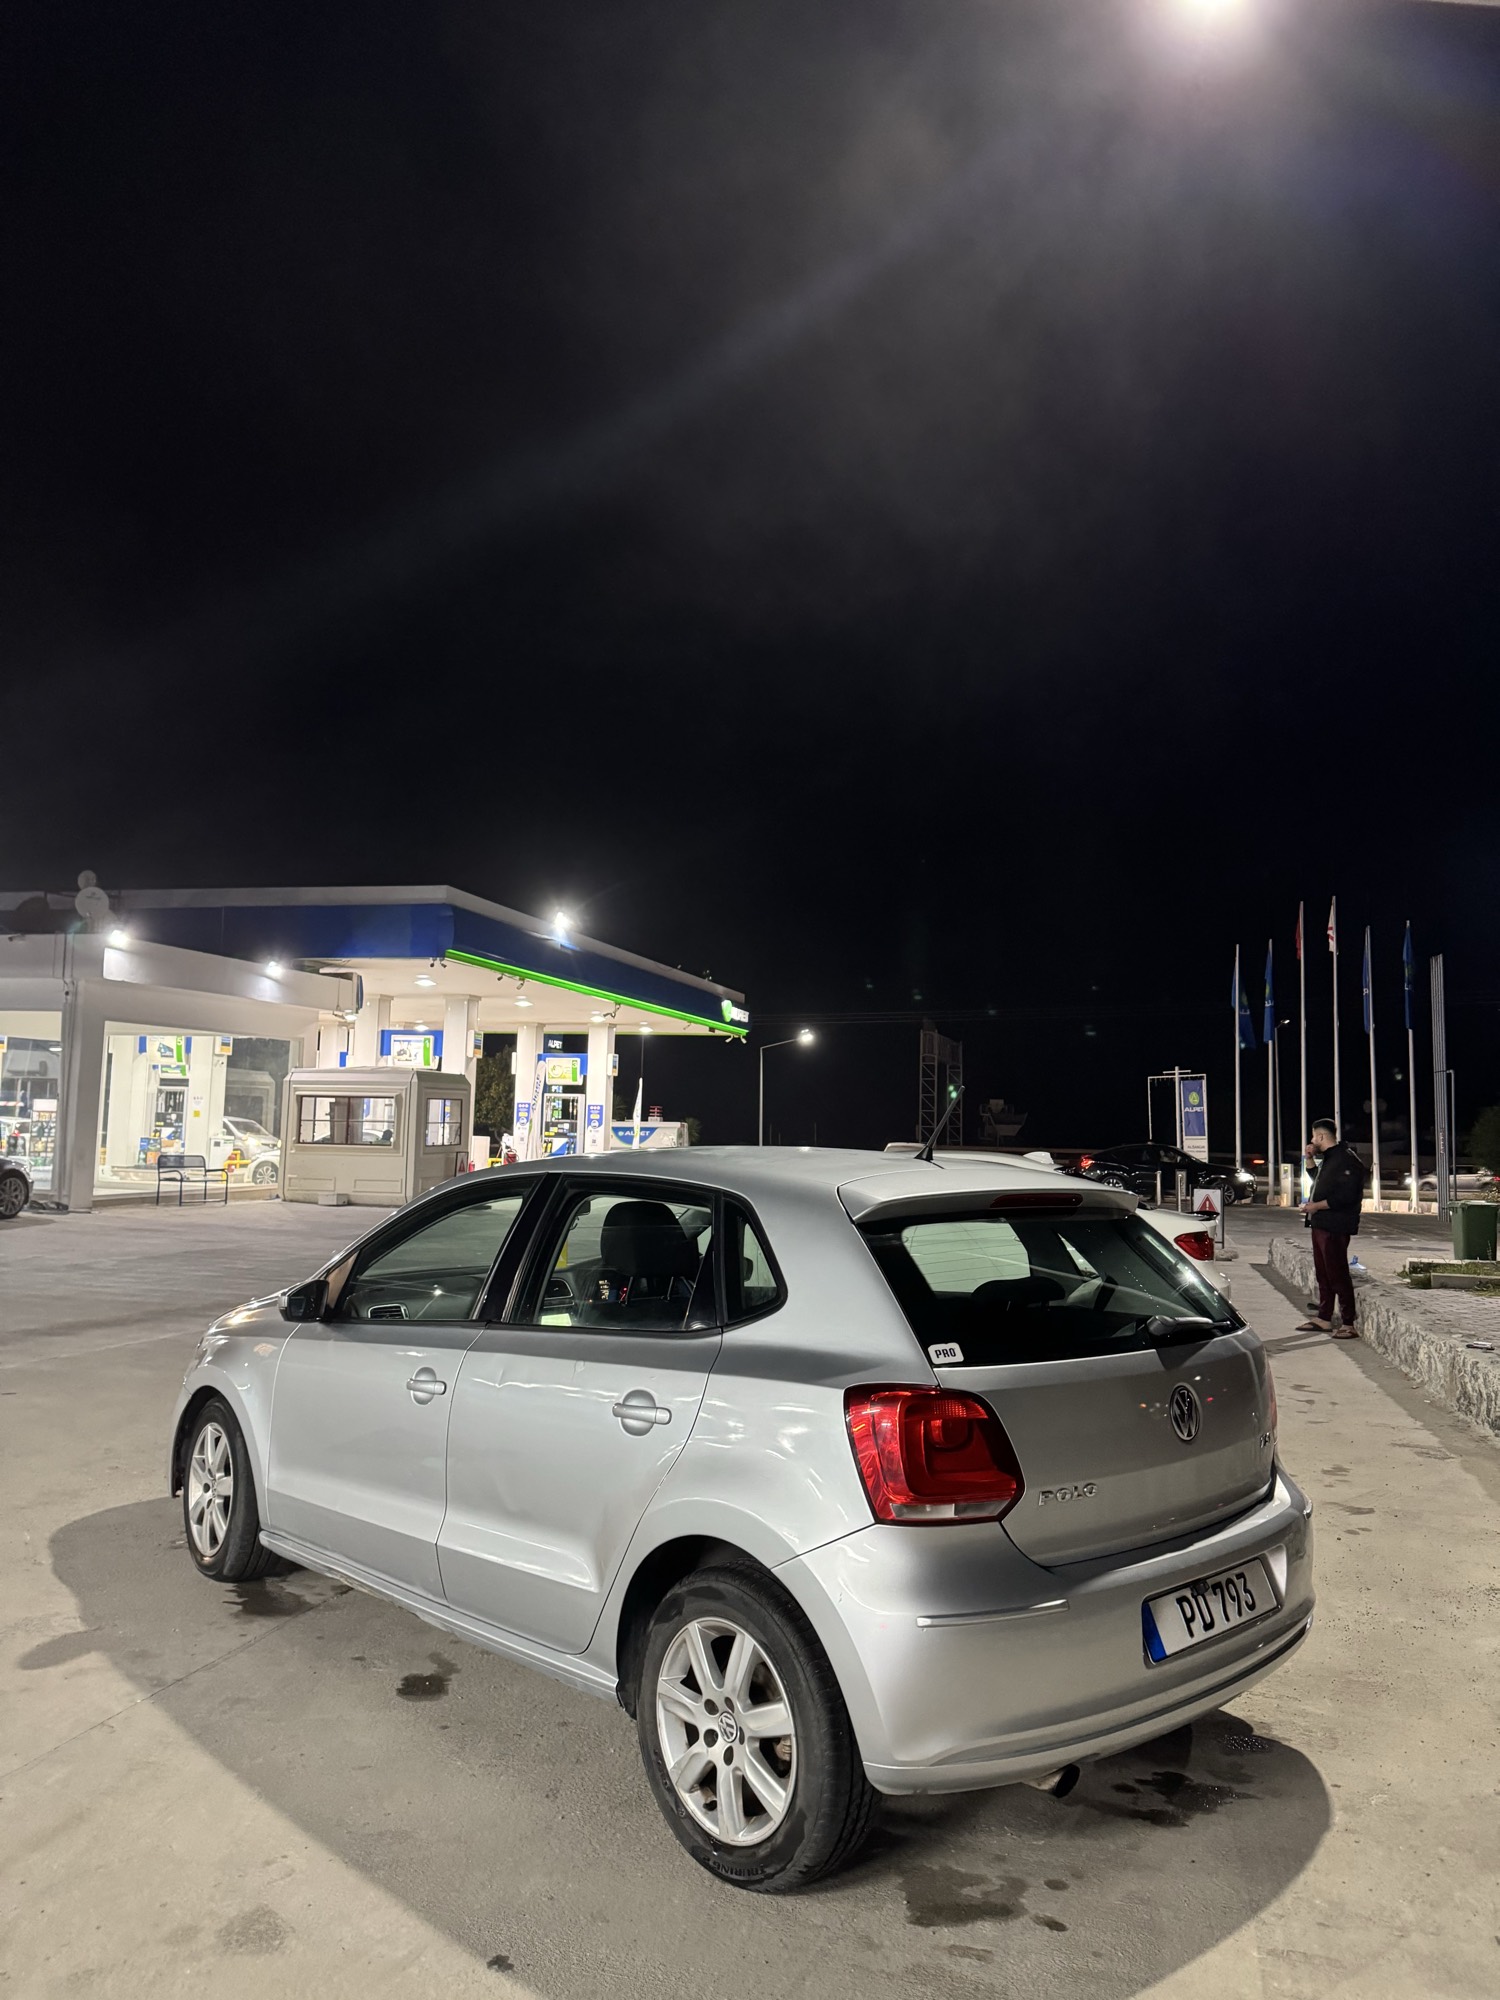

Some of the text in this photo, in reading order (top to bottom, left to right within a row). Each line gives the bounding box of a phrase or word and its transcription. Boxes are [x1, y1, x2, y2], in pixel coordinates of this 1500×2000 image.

[934, 1347, 957, 1359] PRO
[1039, 1482, 1098, 1506] POLO
[1210, 1571, 1257, 1623] 793
